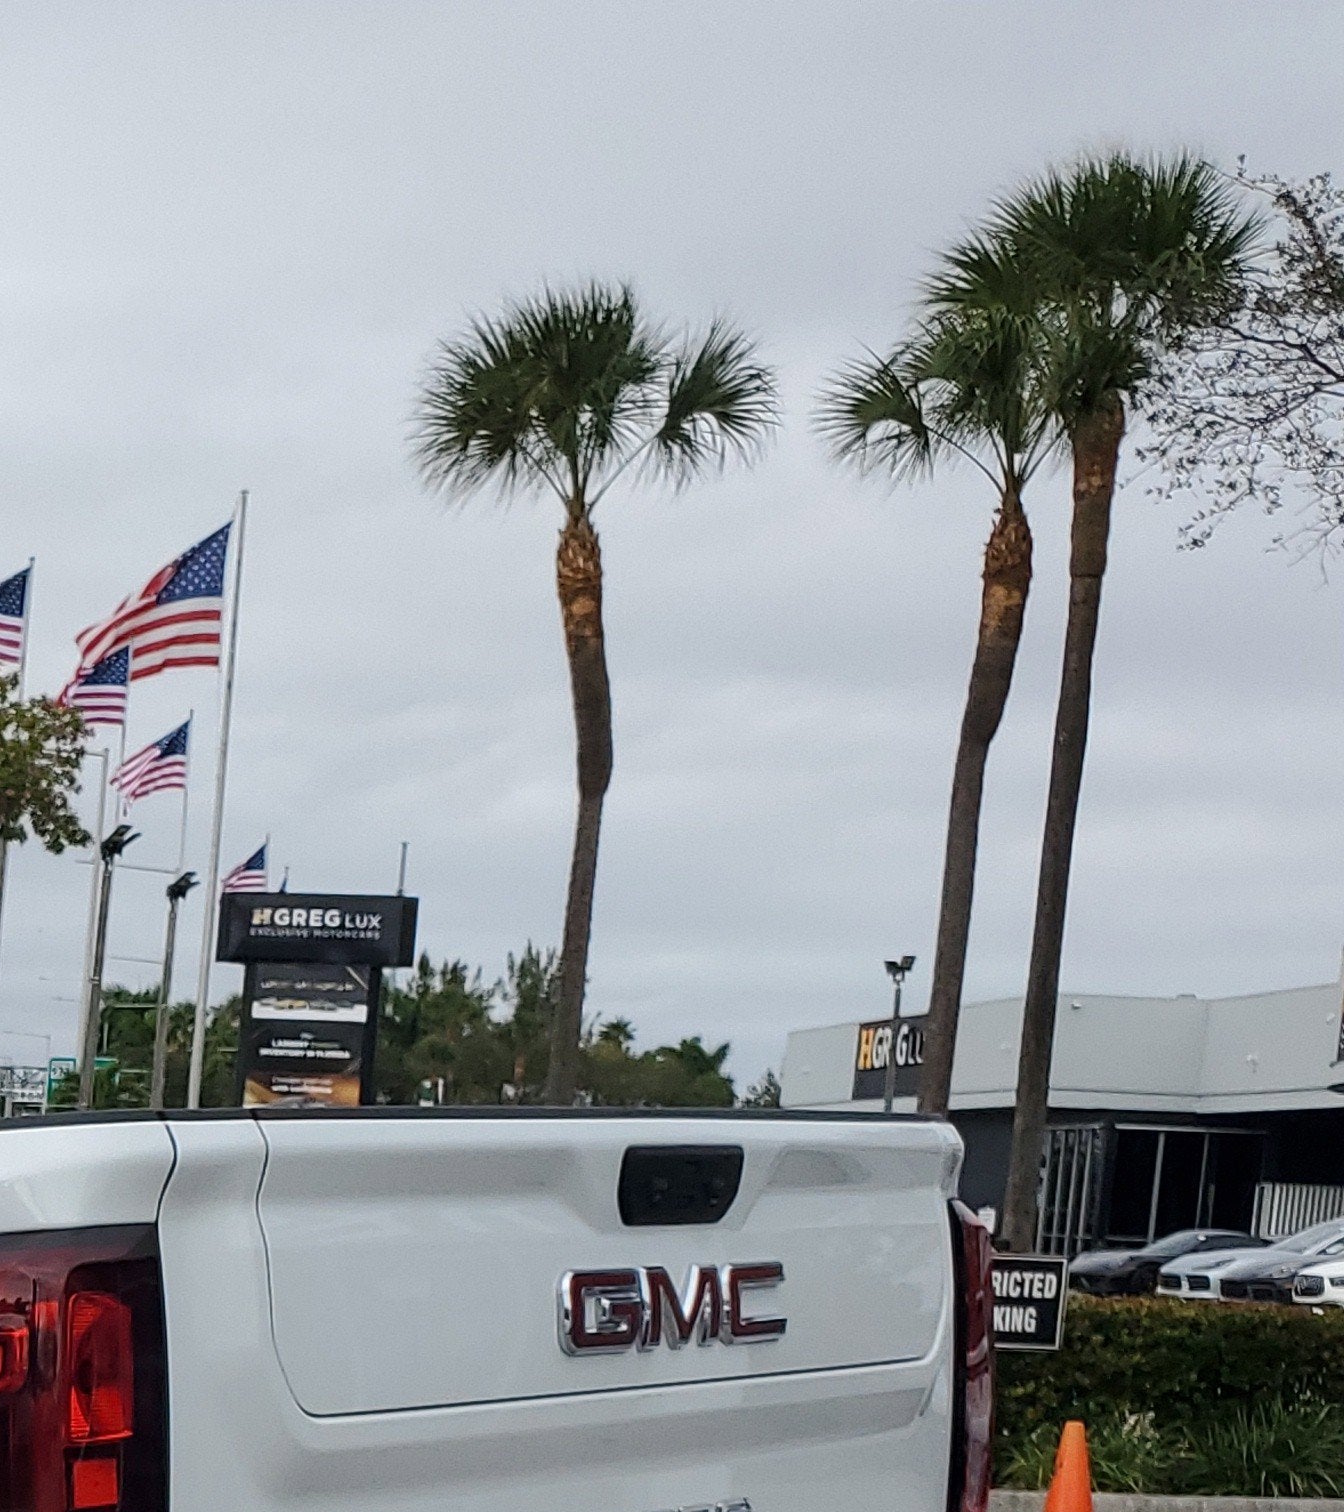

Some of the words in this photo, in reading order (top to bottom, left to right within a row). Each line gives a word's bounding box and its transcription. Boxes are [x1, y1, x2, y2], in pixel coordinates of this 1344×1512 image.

[344, 912, 383, 930] LUX
[857, 1022, 909, 1071] HGRG
[556, 1261, 789, 1358] GMC
[993, 1304, 1038, 1334] KING
